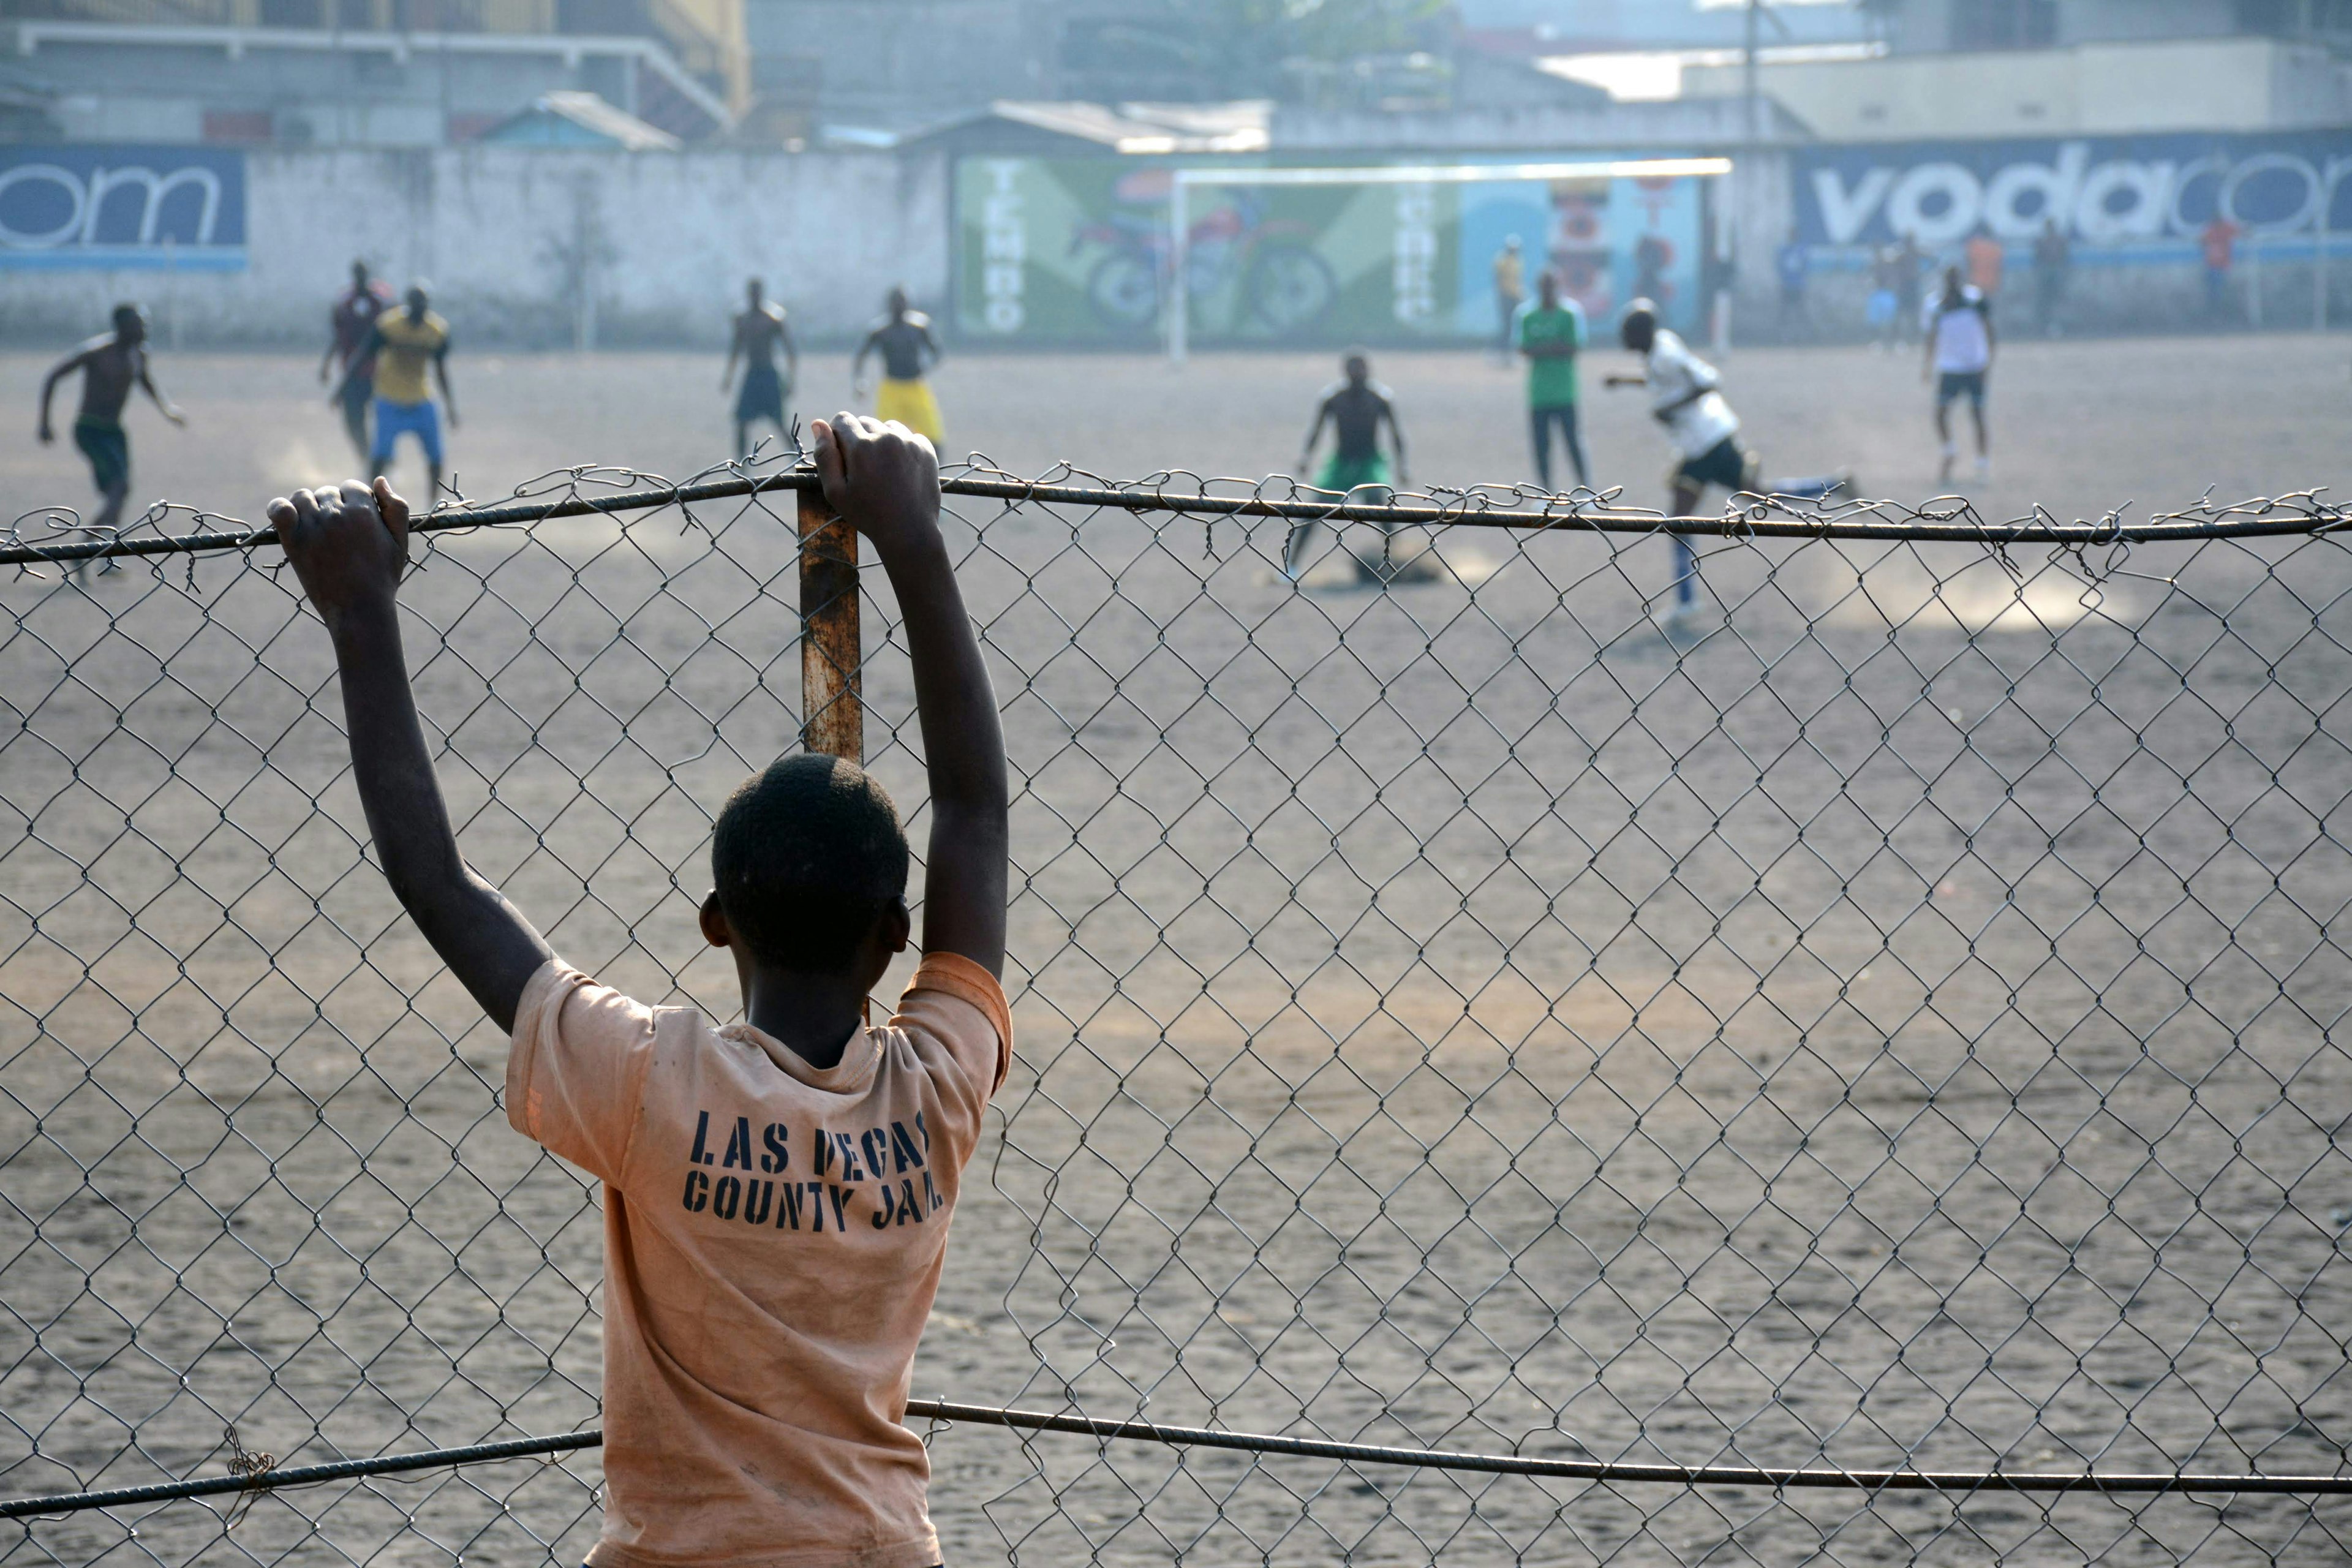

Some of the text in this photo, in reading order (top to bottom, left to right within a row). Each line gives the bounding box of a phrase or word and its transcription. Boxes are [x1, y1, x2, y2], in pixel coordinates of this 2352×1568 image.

[1811, 141, 2352, 243] vodaco
[690, 1110, 789, 1174] LAS
[682, 1170, 855, 1232] COUNTY
